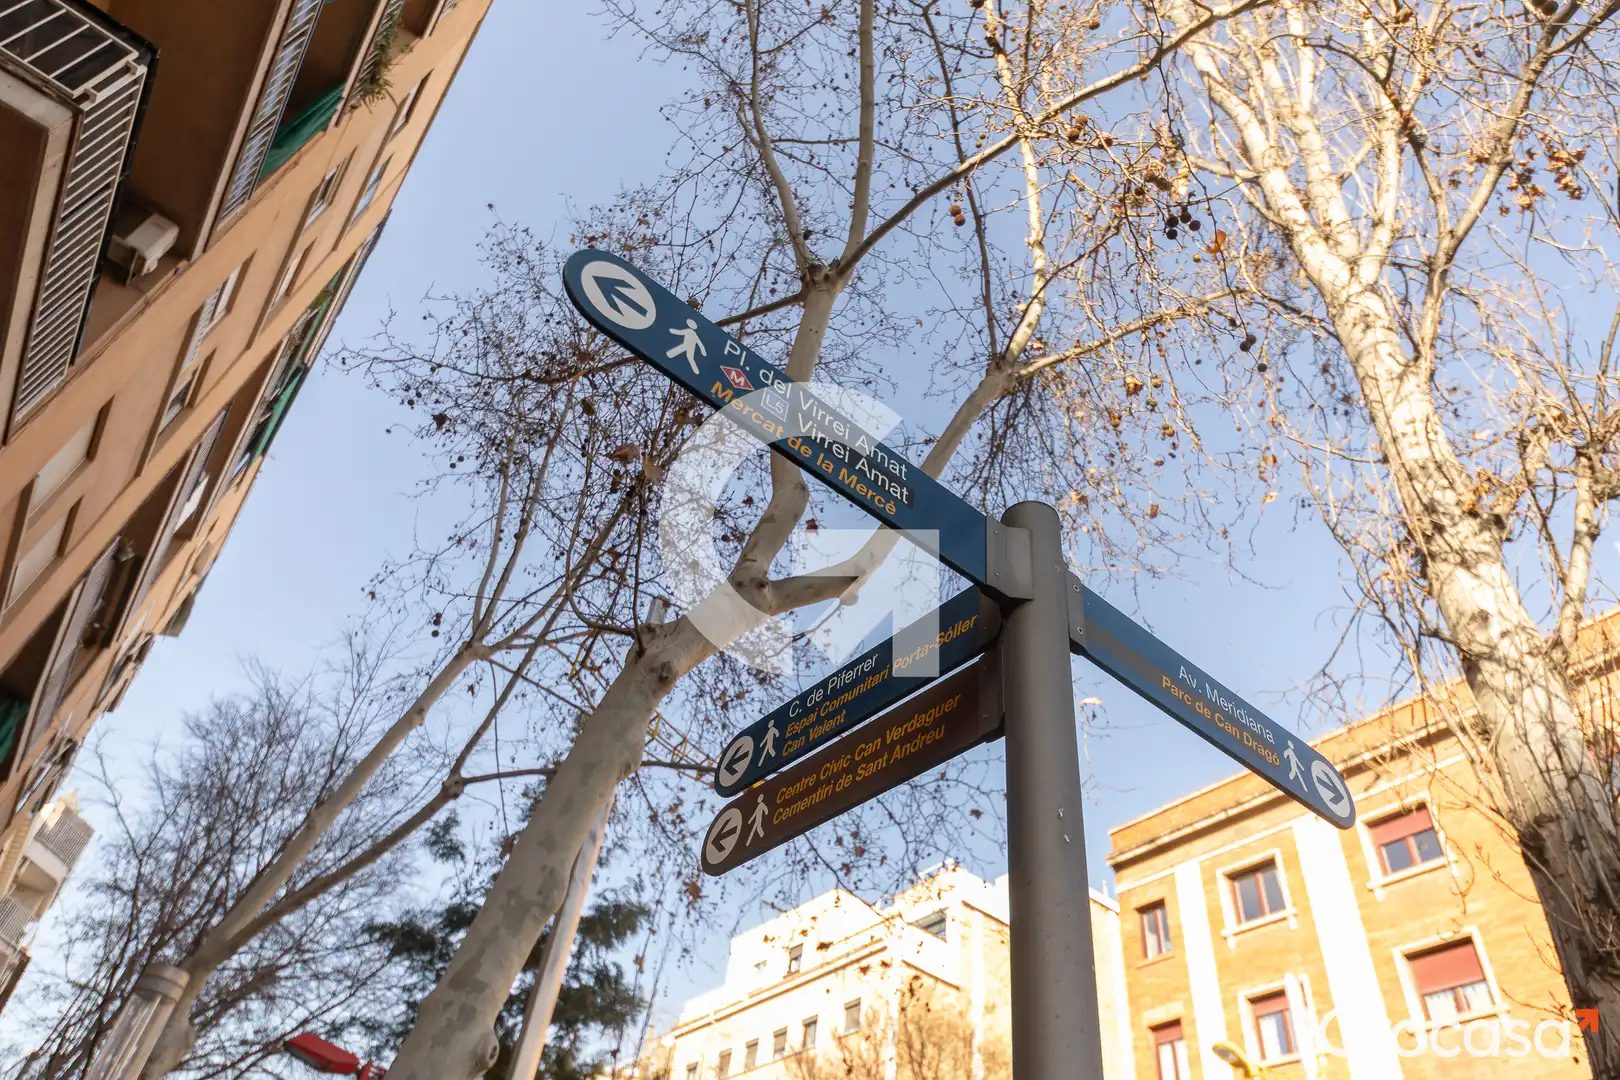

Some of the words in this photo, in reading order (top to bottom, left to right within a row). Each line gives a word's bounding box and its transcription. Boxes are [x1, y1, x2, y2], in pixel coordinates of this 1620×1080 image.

[711, 381, 785, 440] Mercat
[787, 436, 813, 458] de
[816, 453, 835, 474] la
[838, 467, 897, 516] Mercè
[723, 339, 751, 372] Pl.
[759, 369, 792, 399] del
[800, 390, 850, 440] Virrei
[855, 435, 907, 480] Amat
[798, 412, 850, 463] Virrei
[855, 457, 909, 504] Amat
[784, 707, 819, 739] Espai
[820, 663, 890, 717] Comunitari
[789, 700, 803, 718] C.
[806, 688, 824, 707] de
[826, 653, 879, 695] Piferrer
[1161, 675, 1193, 706] Parc
[1194, 701, 1212, 719] de
[1213, 712, 1241, 740] Can
[1242, 731, 1281, 766] Dragó
[1204, 682, 1276, 745] Meridiana
[772, 779, 835, 825] Cementiri
[835, 773, 853, 792] de
[855, 751, 889, 781] Sant
[889, 723, 947, 764] Andreu
[776, 773, 818, 804] Centre
[854, 737, 883, 762] Can
[884, 693, 962, 745] Verdaguer
[782, 736, 806, 757] Can
[808, 708, 847, 742] Valent
